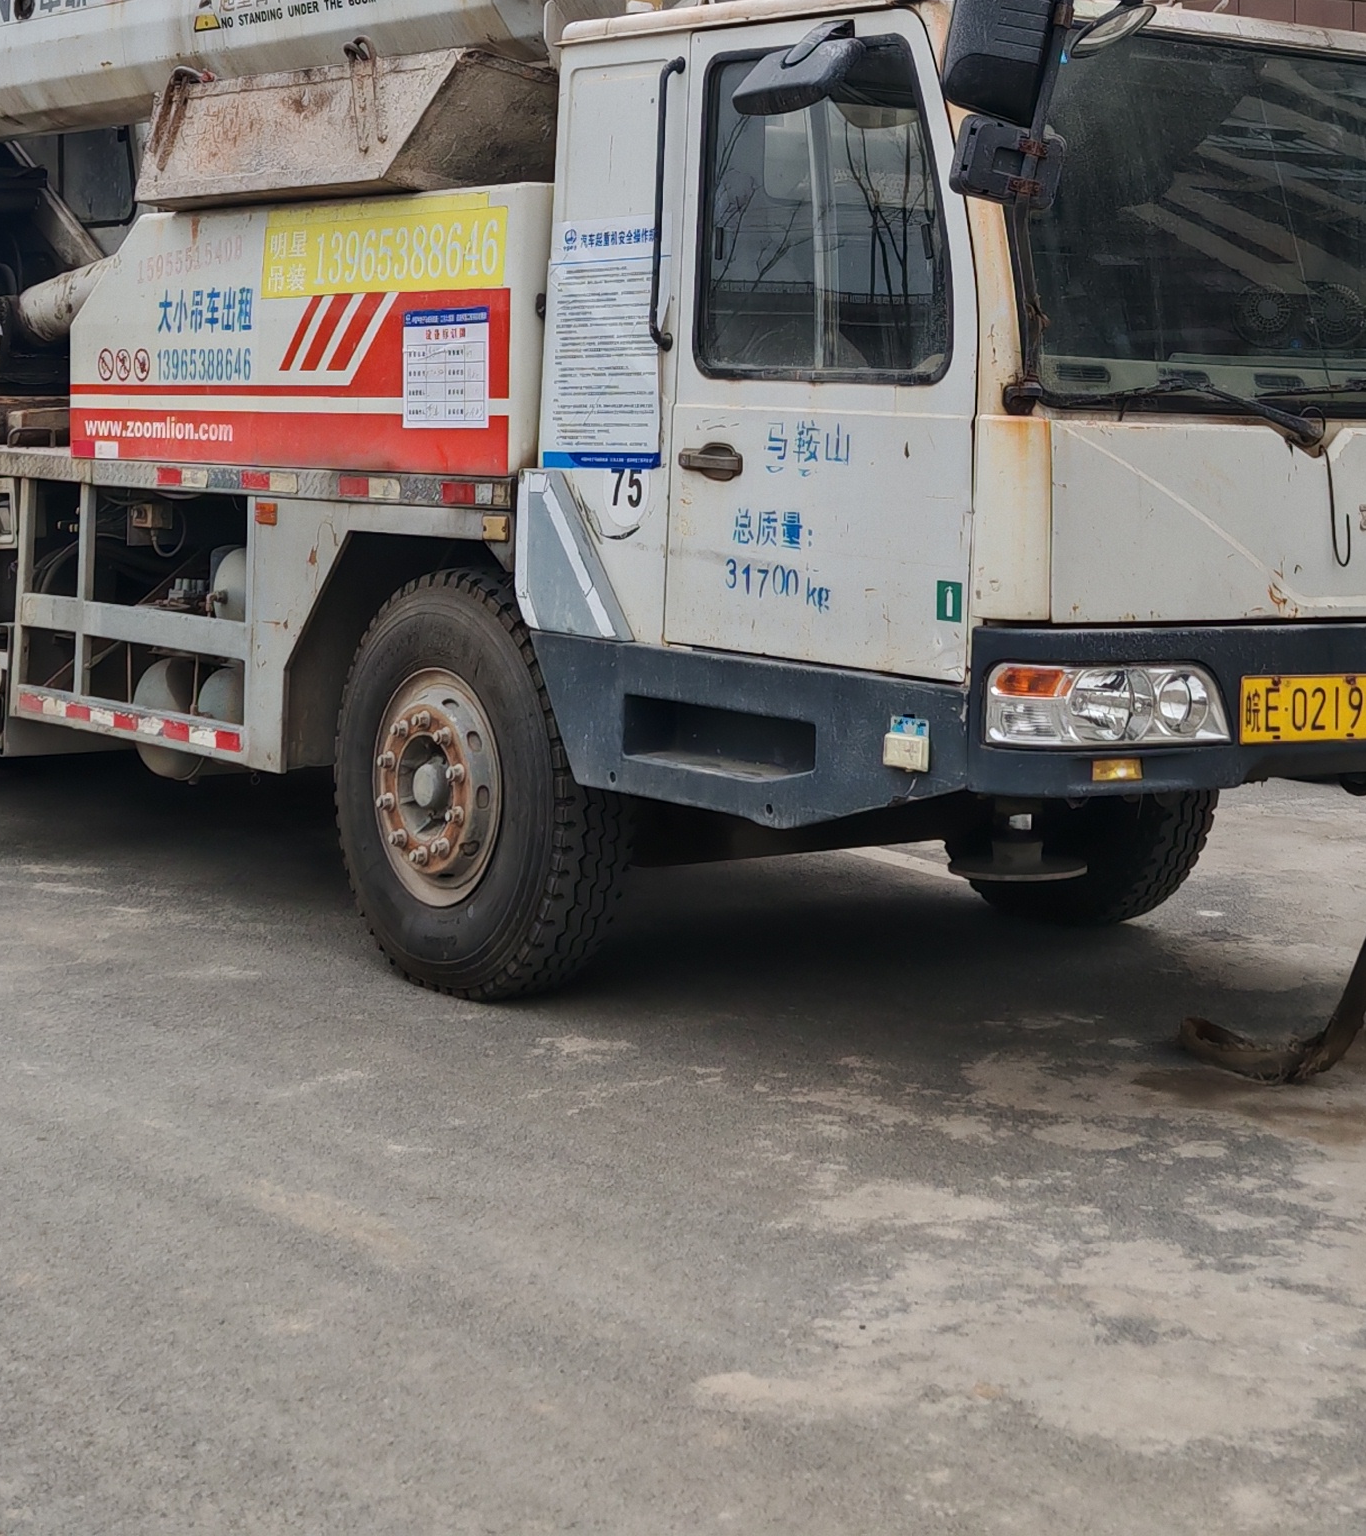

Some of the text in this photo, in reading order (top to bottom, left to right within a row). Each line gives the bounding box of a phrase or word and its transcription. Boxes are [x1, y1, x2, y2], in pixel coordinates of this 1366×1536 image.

[221, 16, 234, 29] NO
[238, 8, 283, 27] STANDING
[287, 1, 320, 18] UNDER
[270, 230, 308, 260] 明星
[314, 219, 499, 285] 13965388646
[267, 263, 308, 293] 吊装
[157, 287, 253, 334] 大小吊车出租
[157, 347, 252, 382] 13965388646
[85, 416, 234, 442] www.zoomlion.com
[764, 420, 850, 465] 马鞍山
[610, 468, 642, 508] 75
